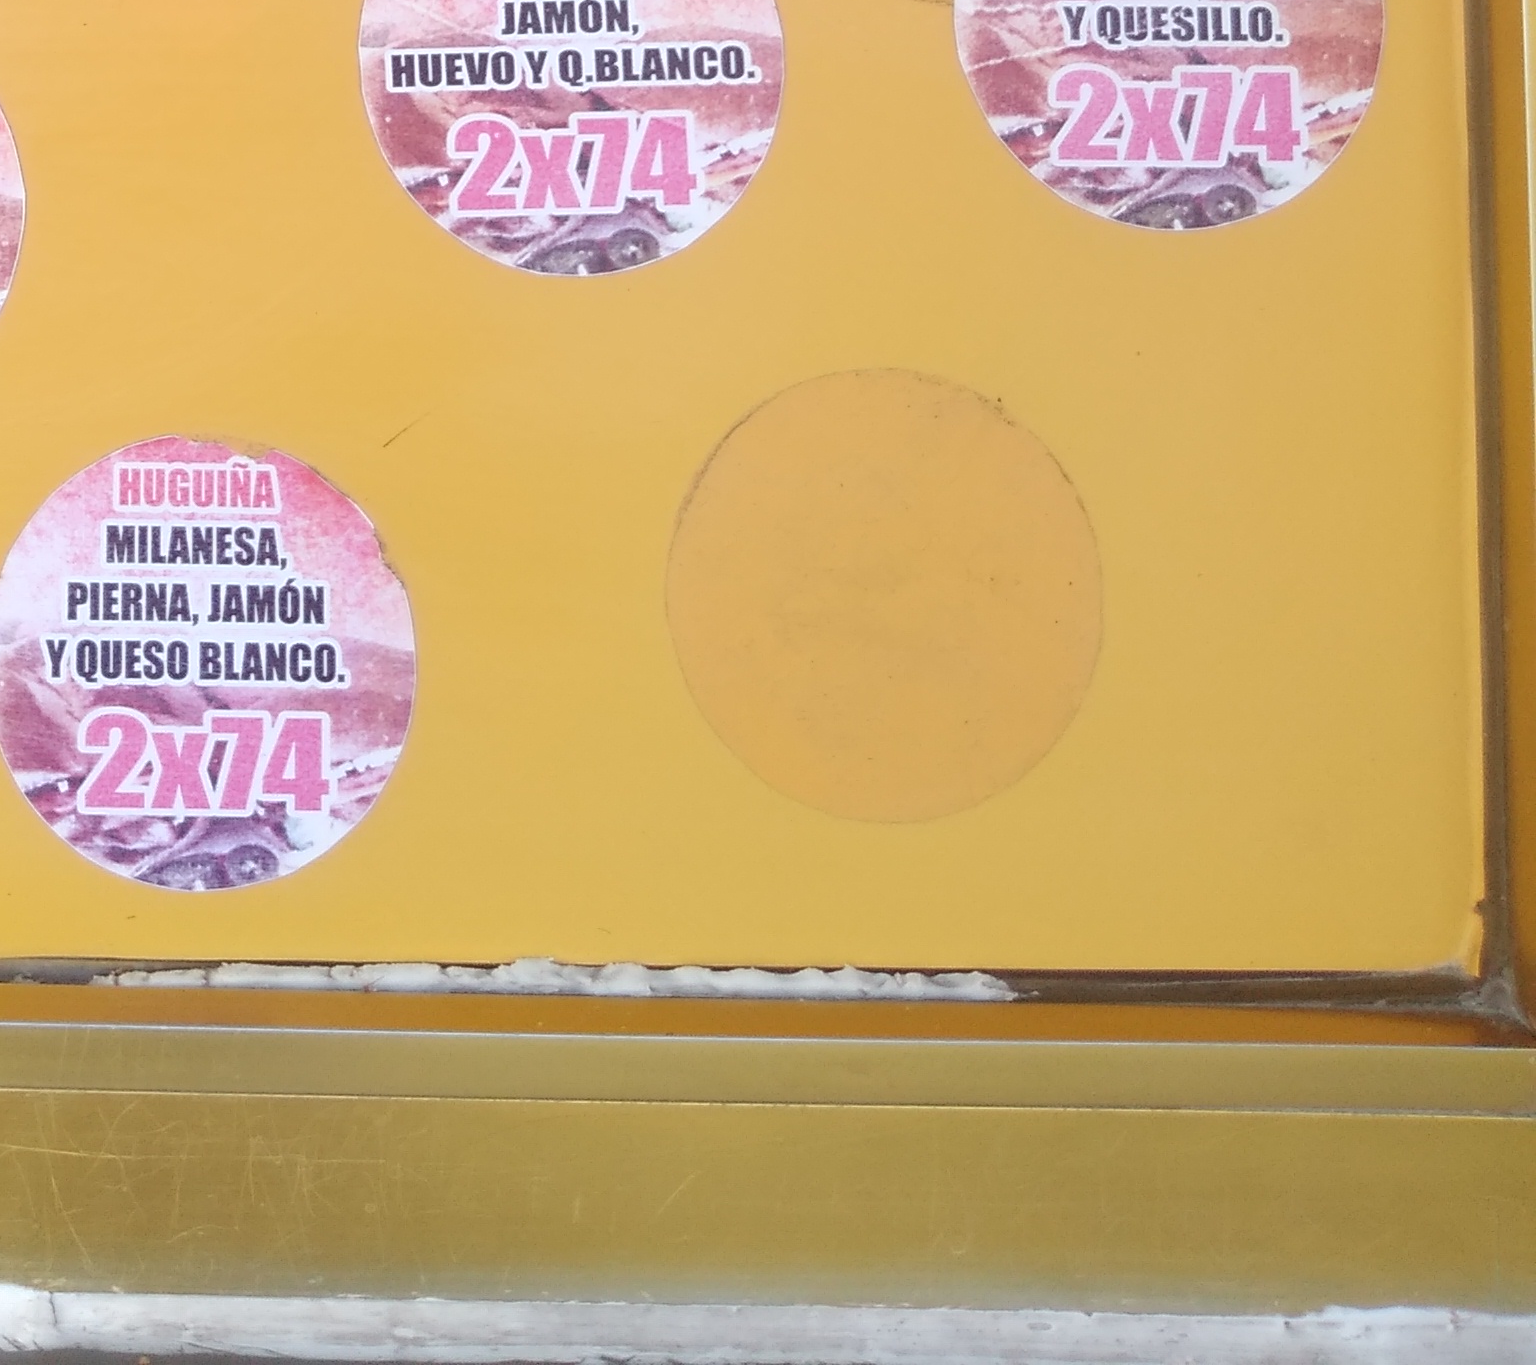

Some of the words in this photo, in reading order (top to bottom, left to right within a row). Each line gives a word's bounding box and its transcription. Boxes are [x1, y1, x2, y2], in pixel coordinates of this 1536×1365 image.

[1061, 4, 1089, 42] Y
[1094, 4, 1286, 46] QUESILLO.
[388, 49, 517, 90] HUEVO
[523, 49, 550, 86] Y
[556, 44, 757, 91] Q.BLANCO.
[1053, 70, 1303, 164] 2x74
[452, 115, 699, 213] 2x74
[116, 460, 278, 510] HUGUIÑA
[103, 523, 290, 572] MILANESA,
[65, 580, 201, 628] PIERNA,
[205, 577, 327, 626] JAMÓN
[44, 637, 68, 679] Y
[73, 638, 191, 684] QUESO
[197, 640, 347, 685] BLANCO.
[82, 711, 332, 813] 2x74
